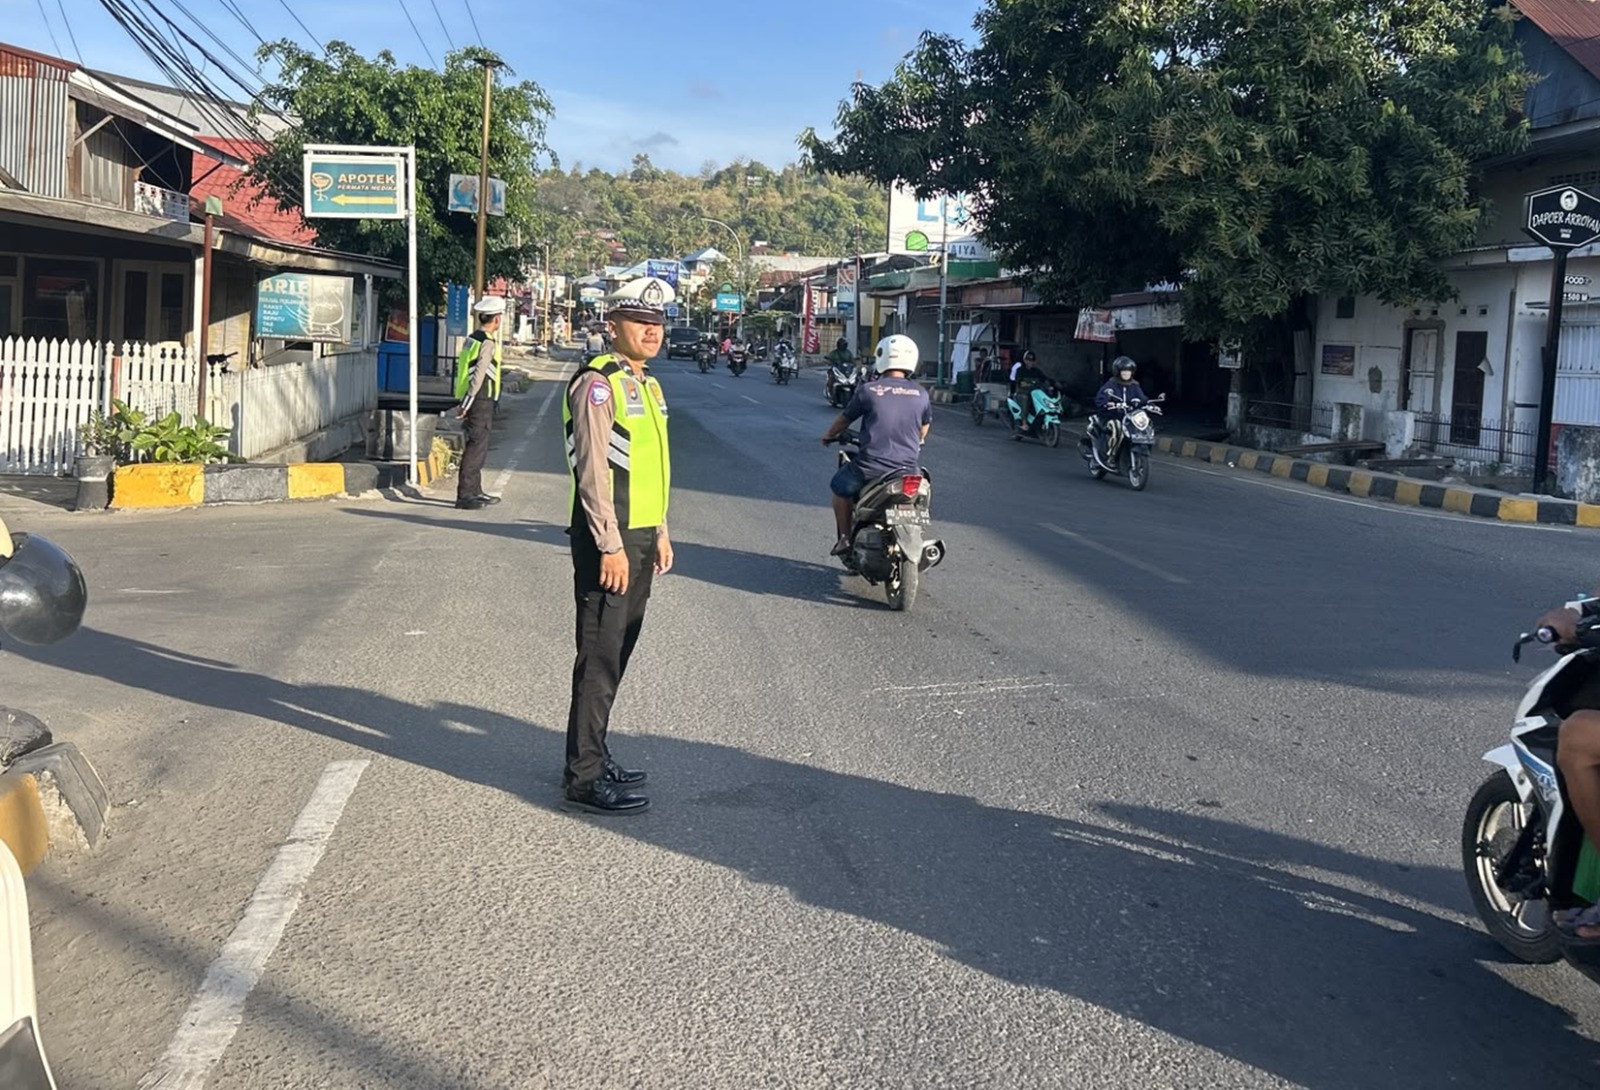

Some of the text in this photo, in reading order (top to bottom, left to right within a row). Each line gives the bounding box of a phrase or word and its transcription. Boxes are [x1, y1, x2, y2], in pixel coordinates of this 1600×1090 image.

[338, 173, 396, 184] APOTEK
[1532, 211, 1564, 228] DAPOER
[839, 285, 853, 293] BNI
